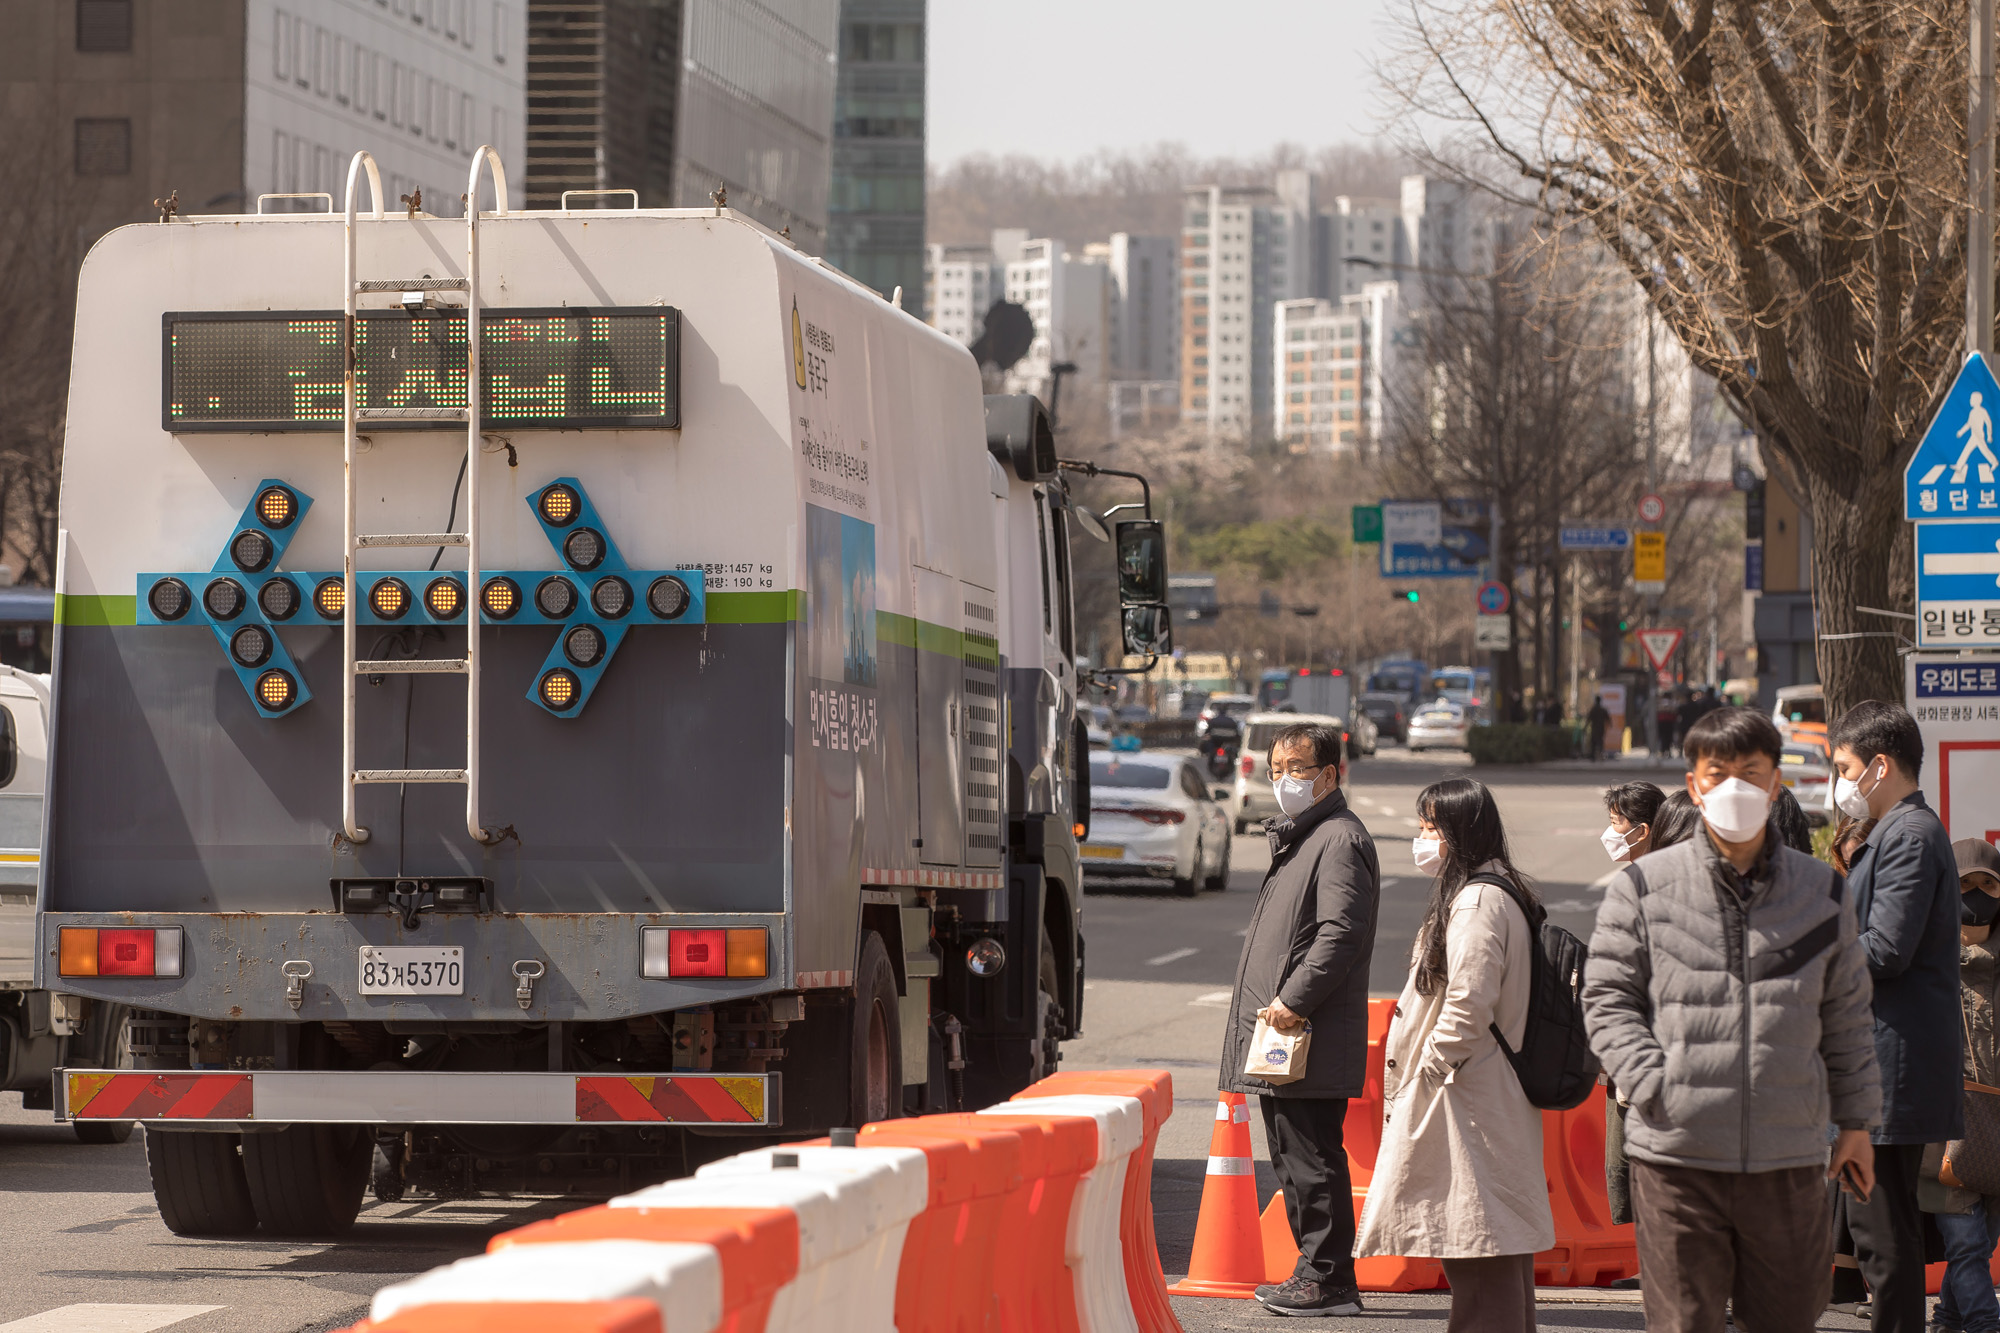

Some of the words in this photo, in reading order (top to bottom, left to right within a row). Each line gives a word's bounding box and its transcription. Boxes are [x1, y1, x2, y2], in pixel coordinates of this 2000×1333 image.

[807, 351, 829, 399] 종로구
[801, 438, 822, 471] 미세먼지를
[822, 445, 835, 474] 줄이기
[843, 453, 860, 482] 종로구의
[1919, 488, 1998, 512] 횡단보
[760, 563, 773, 574] kg
[734, 577, 753, 587] 190
[760, 577, 773, 588] kg
[1921, 668, 1998, 693] 우회도로
[810, 688, 849, 751] 먼지흡입
[851, 694, 878, 755] 청소차
[1917, 705, 1972, 722] 광화문광장
